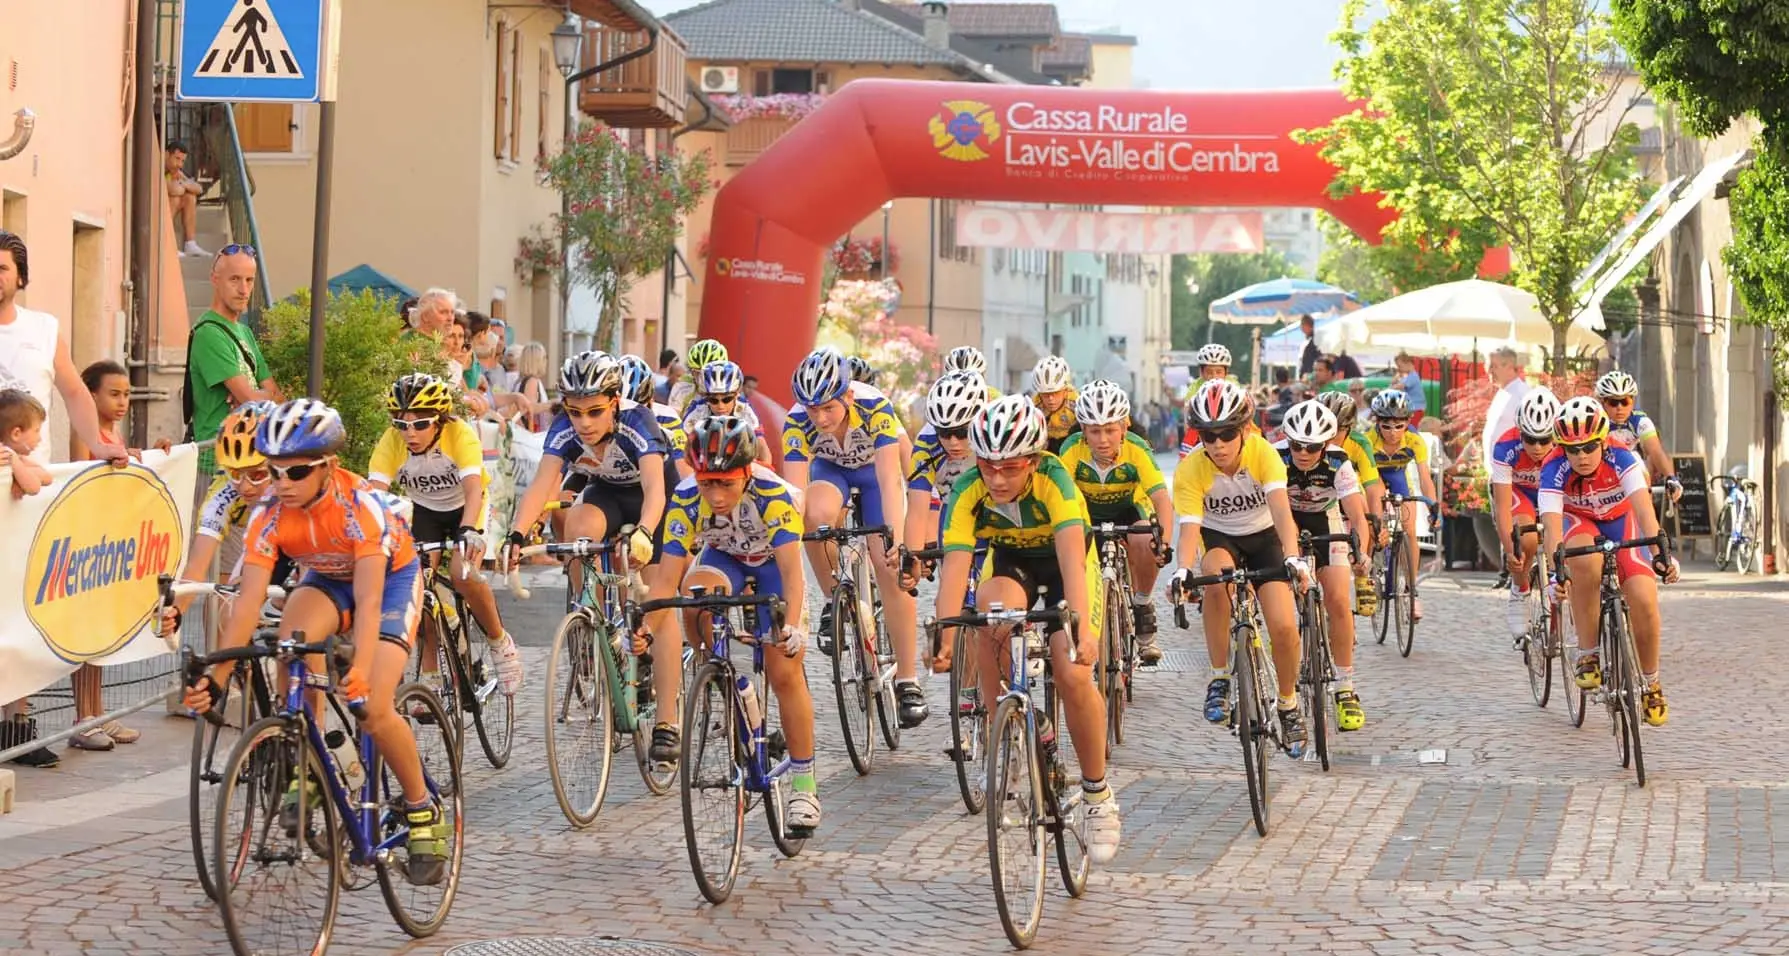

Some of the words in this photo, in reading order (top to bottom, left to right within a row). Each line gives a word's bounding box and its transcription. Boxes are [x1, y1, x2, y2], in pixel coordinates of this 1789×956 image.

[1007, 102, 1093, 130] Cassa
[1098, 105, 1187, 133] Rurale
[1168, 142, 1280, 173] Cembra
[34, 535, 136, 606] Mercatone
[136, 519, 170, 581] Uno
